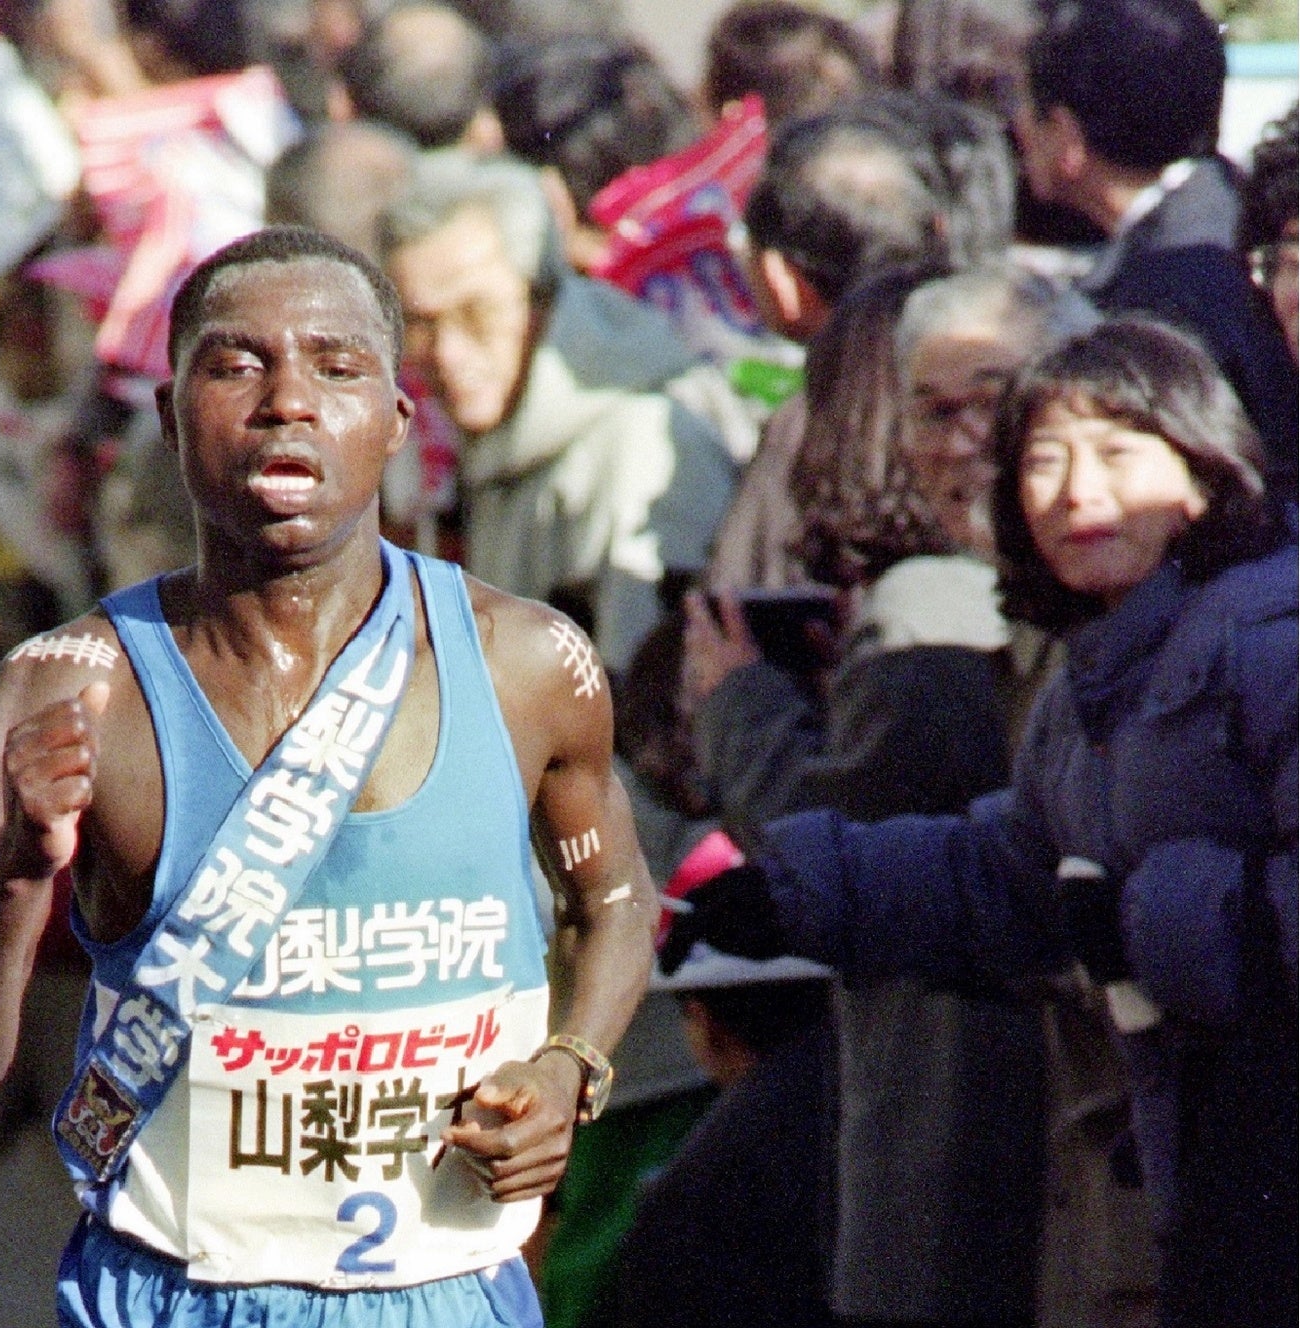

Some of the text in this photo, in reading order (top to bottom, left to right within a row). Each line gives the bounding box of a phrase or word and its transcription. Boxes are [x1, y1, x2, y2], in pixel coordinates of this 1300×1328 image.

[211, 1006, 501, 1076] サッポロビール
[335, 1191, 398, 1273] 2
